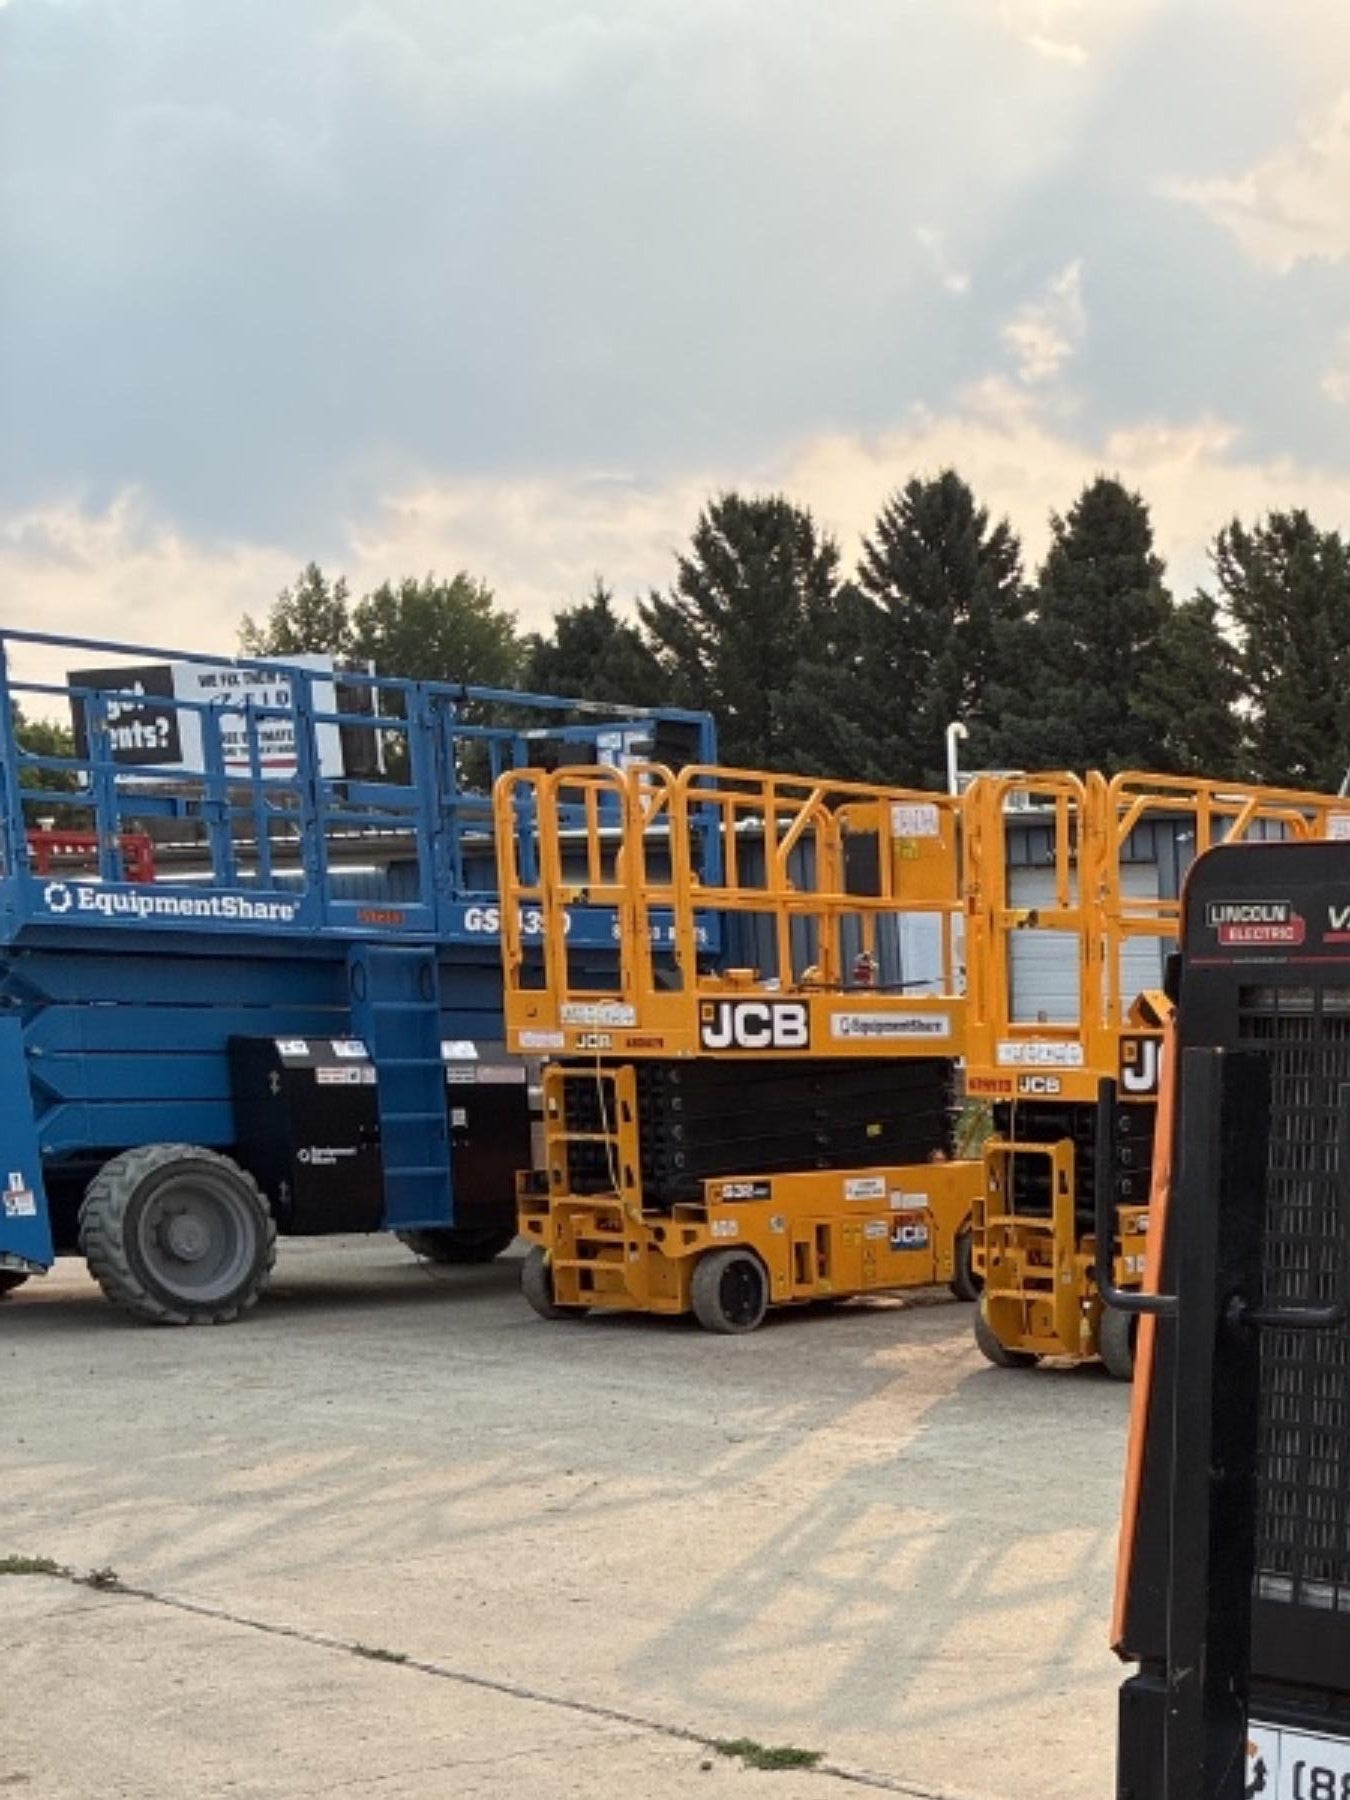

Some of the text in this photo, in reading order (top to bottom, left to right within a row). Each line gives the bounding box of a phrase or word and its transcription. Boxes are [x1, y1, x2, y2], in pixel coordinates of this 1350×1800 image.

[77, 887, 294, 921] EquipmentShare
[1211, 904, 1286, 923] LINCOLN
[1229, 925, 1295, 941] ELECTRIC
[702, 1002, 808, 1048] JCB
[1019, 1076, 1060, 1094] JCB
